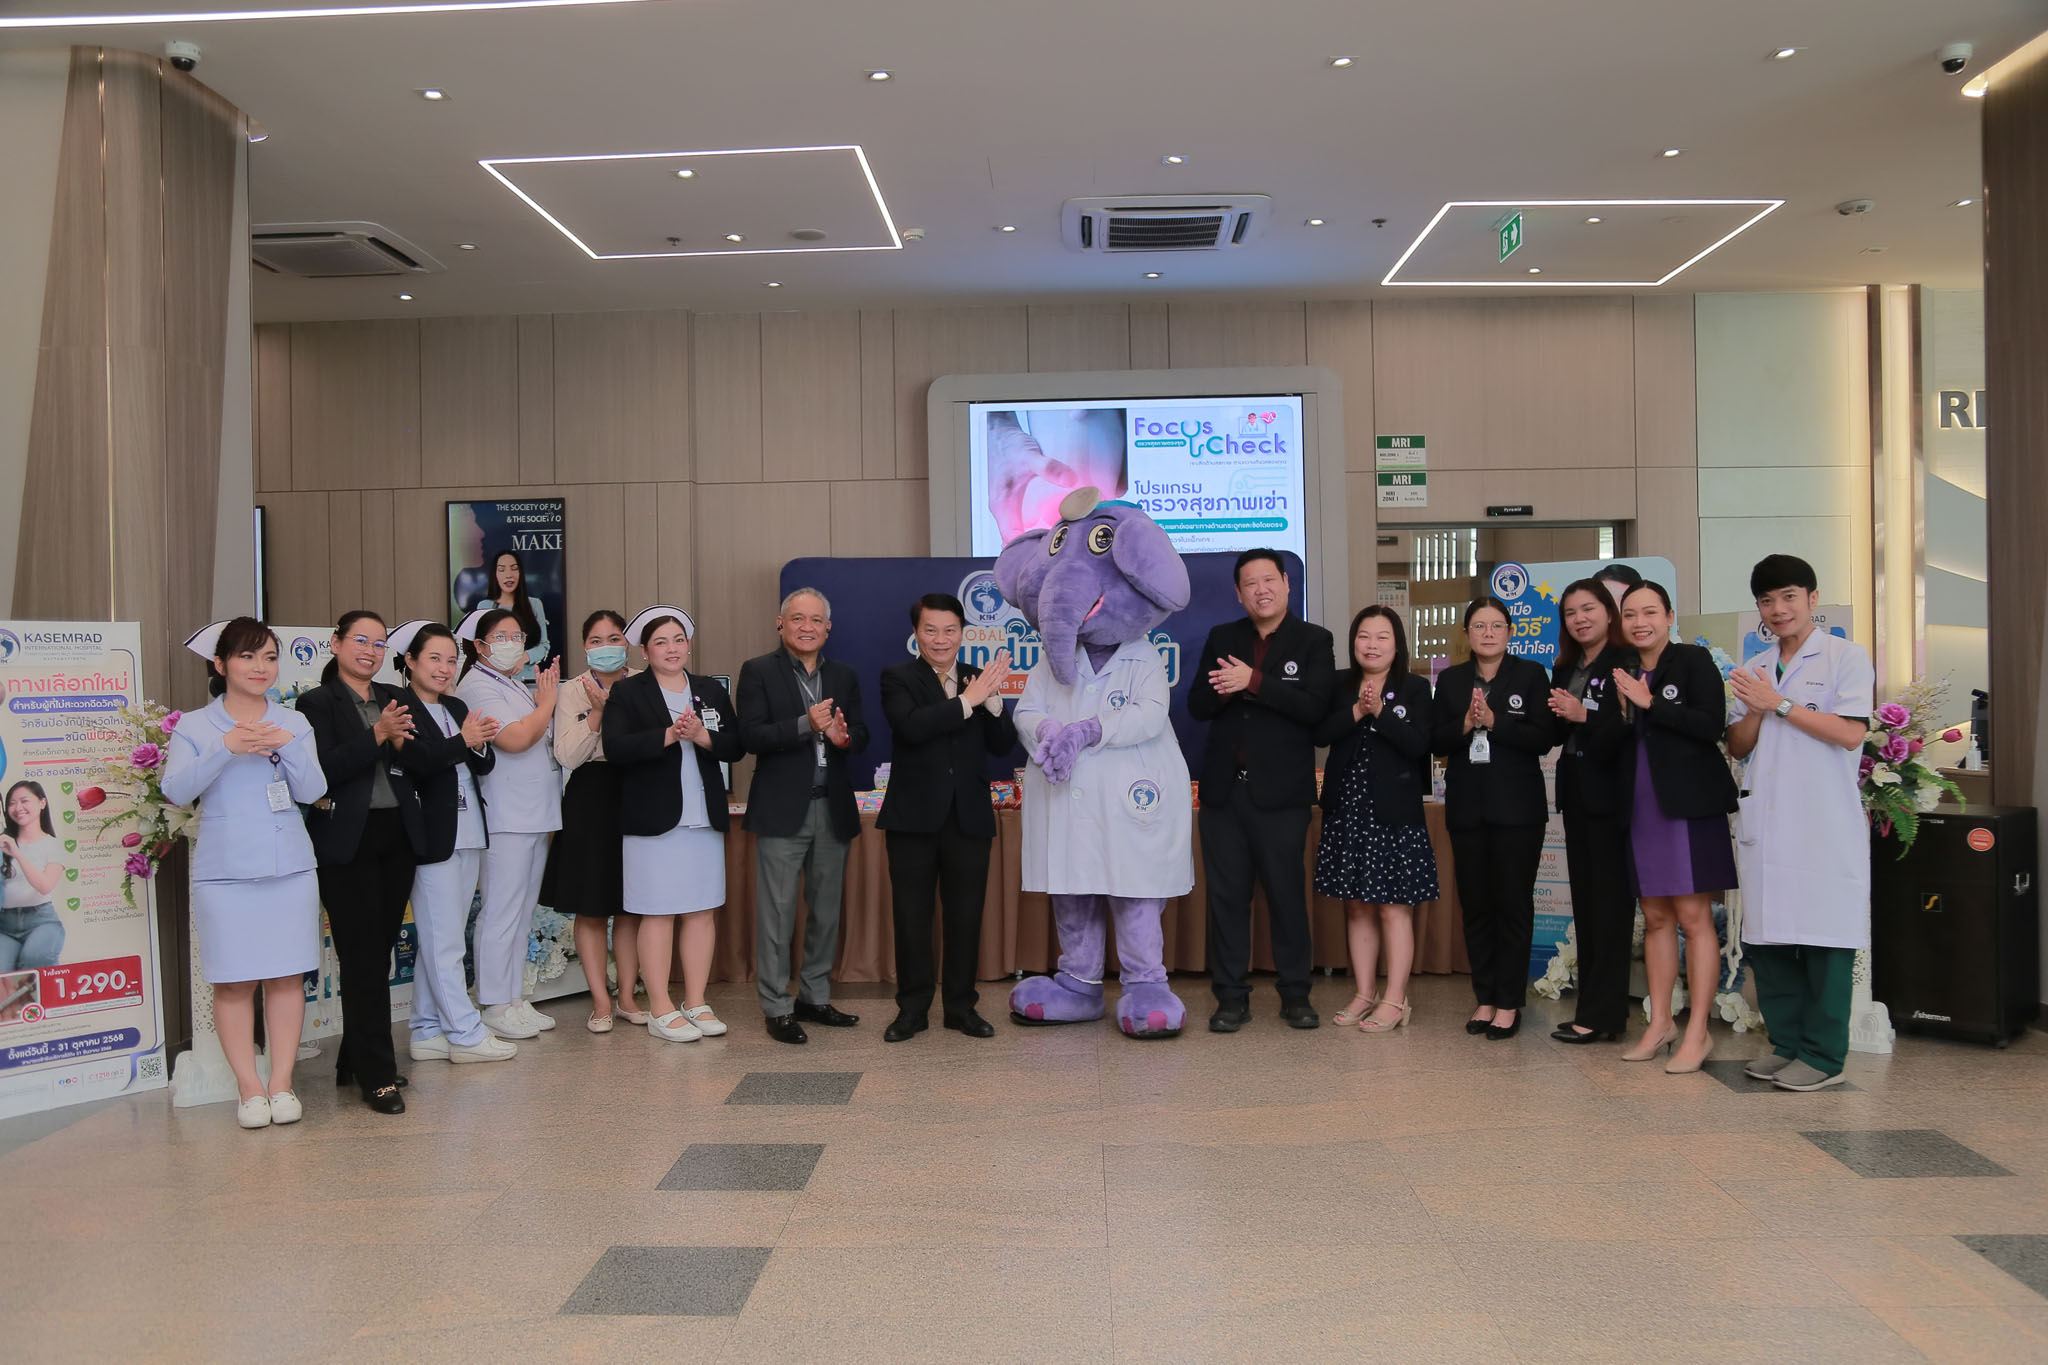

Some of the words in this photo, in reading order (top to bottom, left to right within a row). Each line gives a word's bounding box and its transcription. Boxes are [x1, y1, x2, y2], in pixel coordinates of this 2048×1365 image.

[1135, 417, 1213, 438] Focus
[1206, 433, 1287, 455] Check
[1391, 437, 1411, 448] MRI
[1392, 474, 1412, 485] MRI
[1134, 480, 1202, 495] โปรแกรม
[496, 503, 510, 511] THE
[510, 503, 539, 511] SOCIETY
[539, 503, 549, 511] OF
[1138, 490, 1288, 517] ตรวจสุขภาพเข่า
[506, 515, 512, 523] &
[511, 515, 526, 523] THE
[24, 633, 103, 643] KASEMRAD
[965, 629, 1005, 641] OBAL
[8, 671, 128, 693] ทางเลือกใหม่
[24, 767, 43, 778] ข้อดี
[8, 1042, 49, 1060] ตั้งแต่วันนี้
[58, 1041, 69, 1052] 31
[72, 1038, 101, 1051] ตุลาคม
[103, 1033, 125, 1044] 2568
